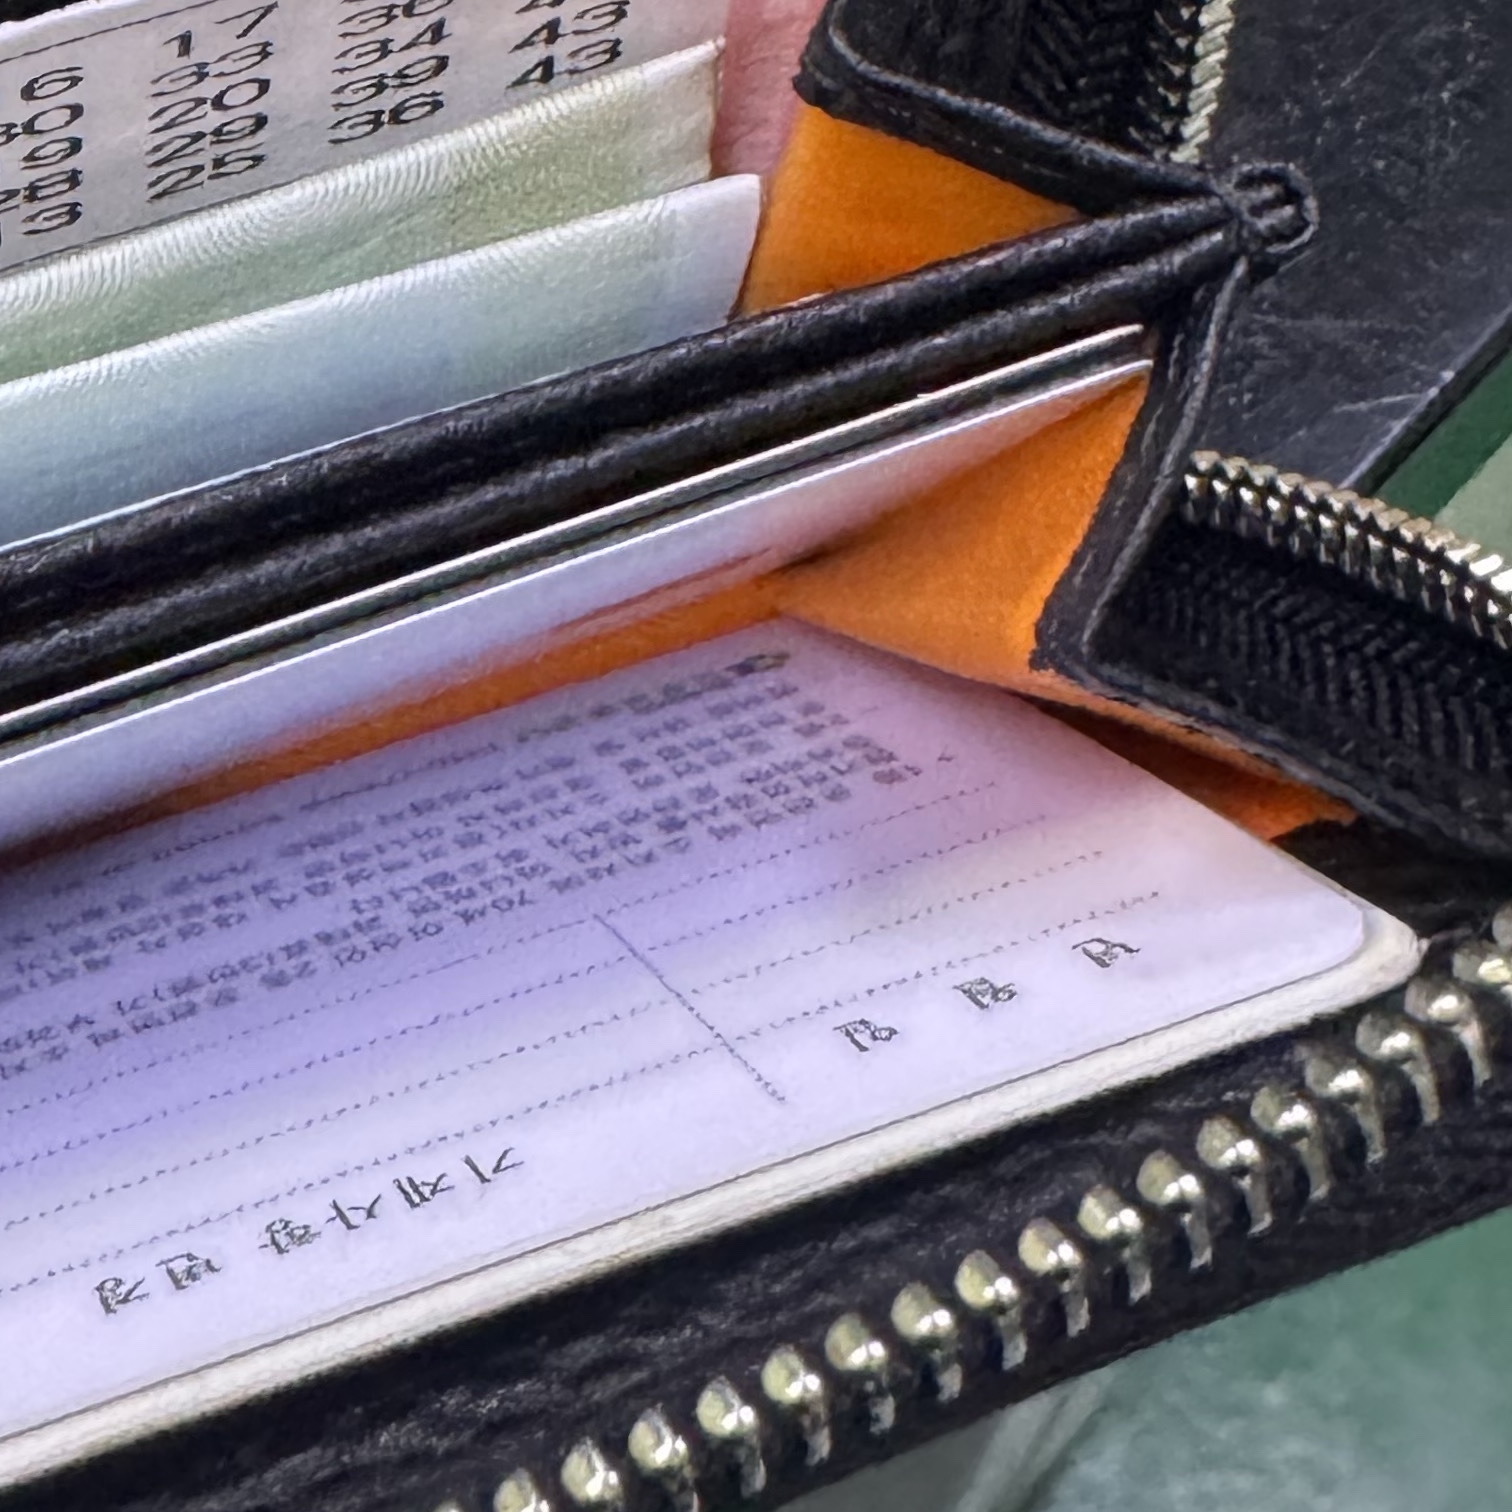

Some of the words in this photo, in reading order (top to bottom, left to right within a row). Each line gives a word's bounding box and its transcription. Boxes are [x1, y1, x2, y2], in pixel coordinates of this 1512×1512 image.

[146, 111, 268, 168] 29
[508, 0, 630, 54] 43
[148, 77, 271, 134] 20
[332, 16, 453, 74] 34
[150, 40, 274, 97] 33
[162, 0, 279, 59] 17
[146, 141, 267, 204] 25
[327, 90, 445, 144] 36
[505, 37, 622, 90] 43
[257, 1146, 526, 1257] 기재사항
